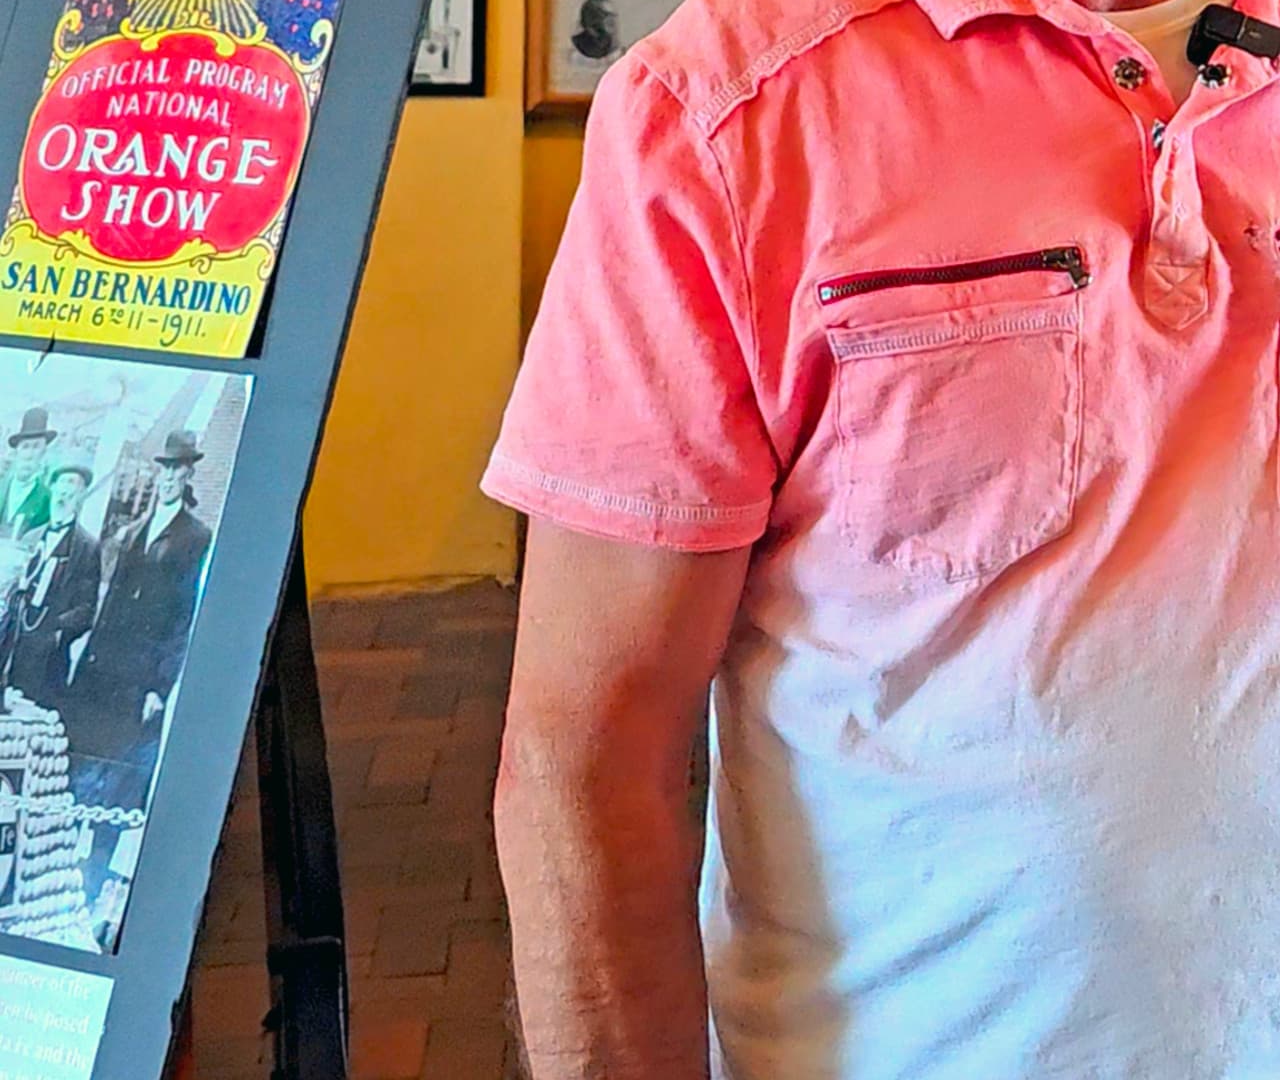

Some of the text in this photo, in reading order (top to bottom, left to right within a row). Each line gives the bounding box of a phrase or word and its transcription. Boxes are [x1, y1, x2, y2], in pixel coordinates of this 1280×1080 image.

[61, 57, 290, 110] OFFICIAL PROGRAM
[106, 91, 231, 128] NATIONAL
[38, 124, 278, 185] ORANGE
[61, 181, 221, 231] SHOW
[1, 261, 250, 317] SAN BERNARDINO
[19, 299, 83, 322] MARCH
